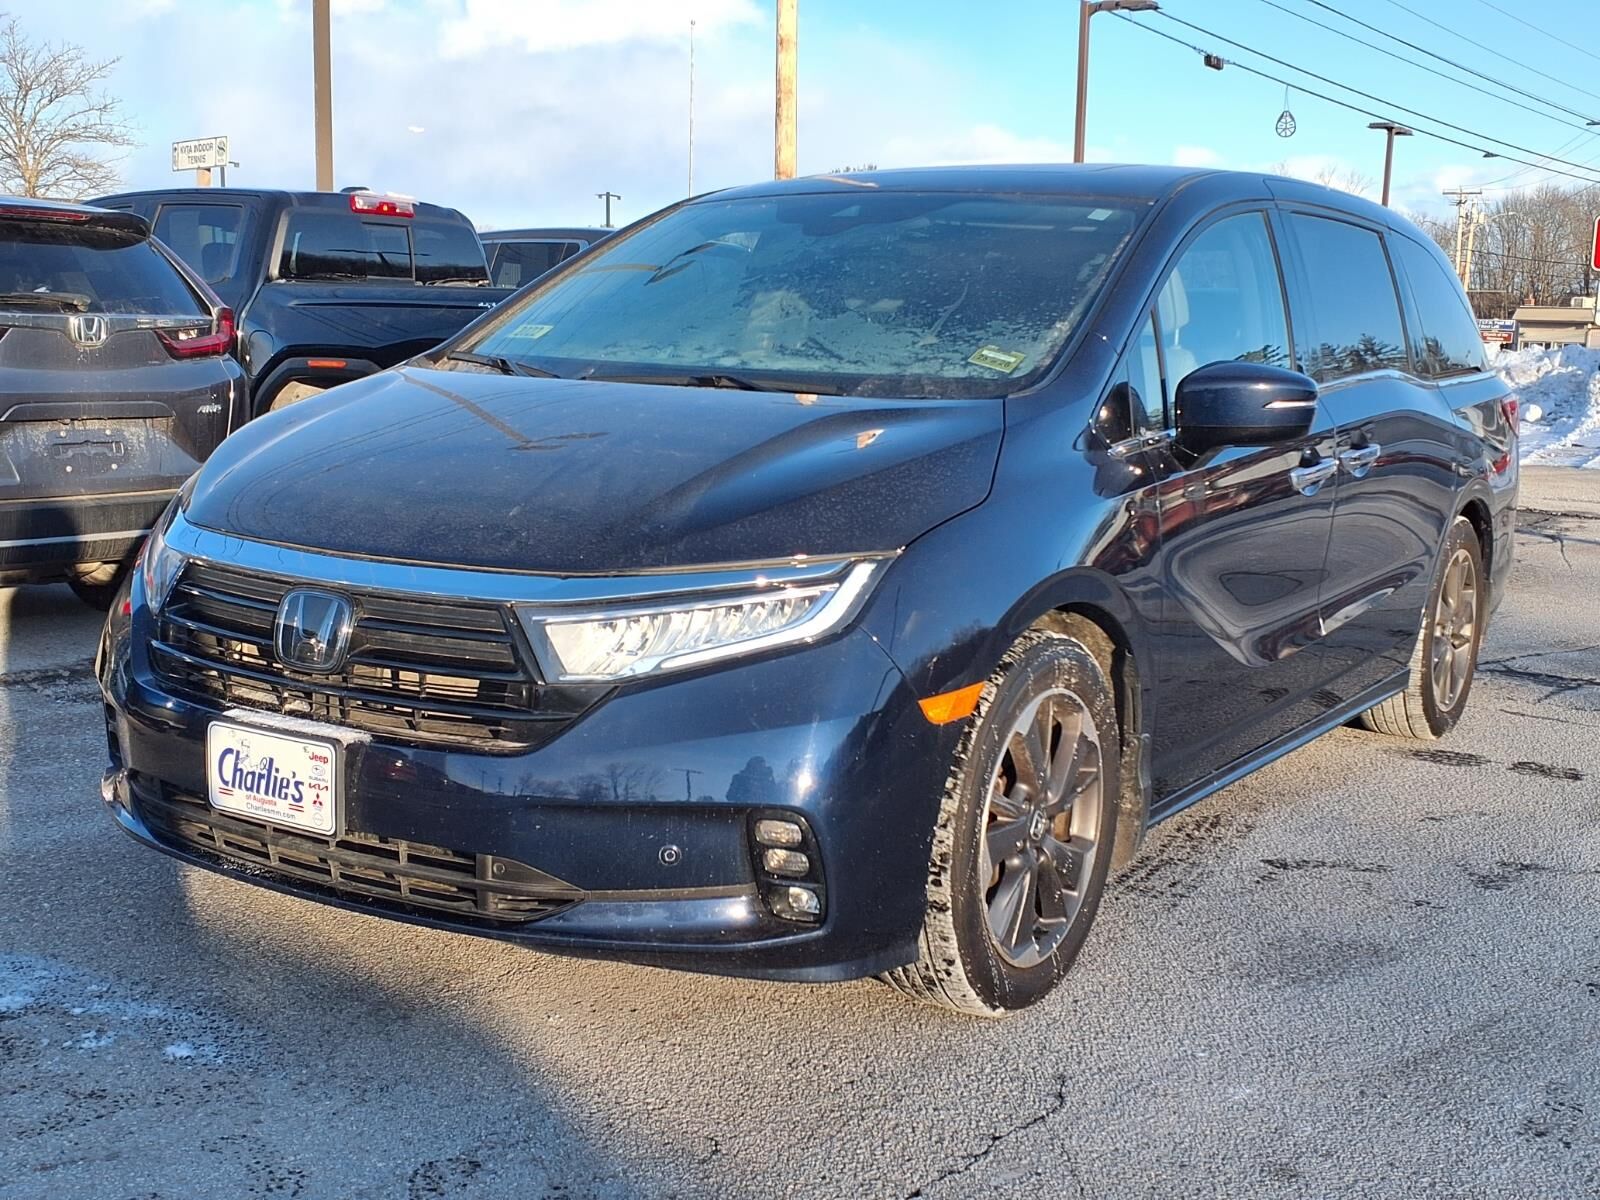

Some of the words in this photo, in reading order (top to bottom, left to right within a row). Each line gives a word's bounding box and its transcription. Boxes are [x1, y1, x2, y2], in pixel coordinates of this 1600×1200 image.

[193, 142, 214, 153] INDOOR
[188, 155, 206, 165] TENNIS
[308, 751, 329, 765] Jeep
[217, 747, 305, 804] Charlie's
[252, 794, 277, 807] Augusta
[246, 802, 296, 820] Charliesmm.com
